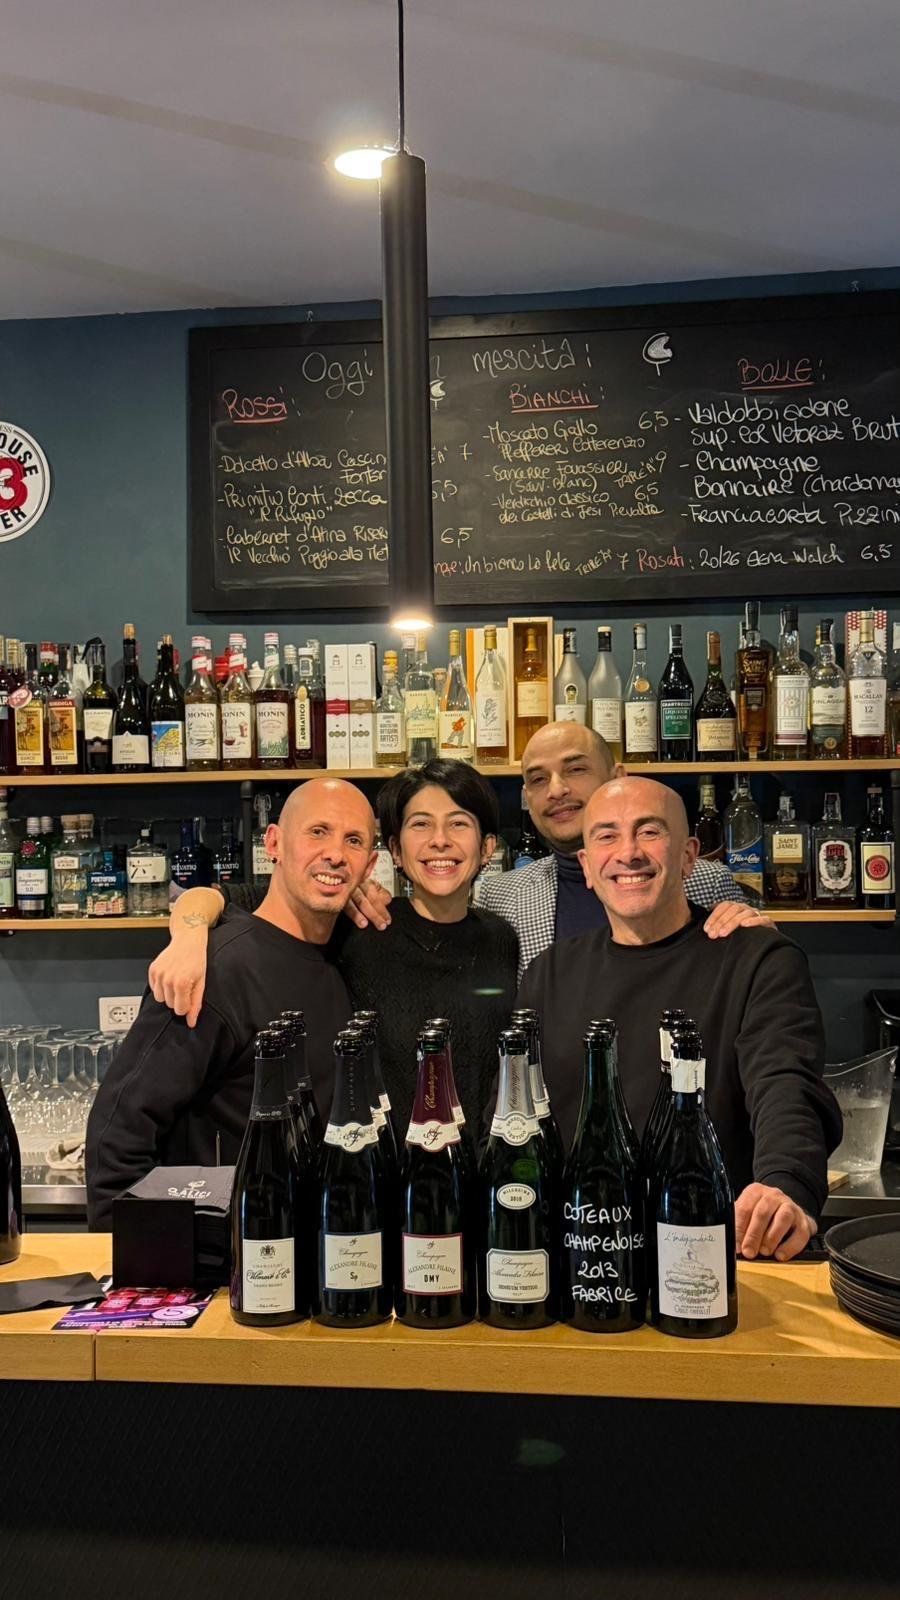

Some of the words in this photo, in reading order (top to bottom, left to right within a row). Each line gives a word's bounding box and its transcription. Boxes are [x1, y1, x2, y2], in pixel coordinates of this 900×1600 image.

[302, 349, 374, 400] Oggi
[553, 418, 599, 442] Gallo
[638, 410, 669, 433] 6,5
[695, 450, 821, 481] Champagne
[287, 485, 327, 506] Conti
[634, 481, 659, 503] 6,5
[694, 474, 795, 499] Bonnaire
[440, 527, 474, 550] 6,5
[860, 543, 894, 563] 6,5
[187, 711, 215, 719] MONIN
[257, 711, 286, 719] MONIN
[776, 842, 799, 850] JAMES
[563, 1201, 633, 1224] COTEAUX
[501, 1256, 534, 1269] Champagne
[577, 1260, 619, 1279] 2013
[423, 1274, 440, 1283] DMY
